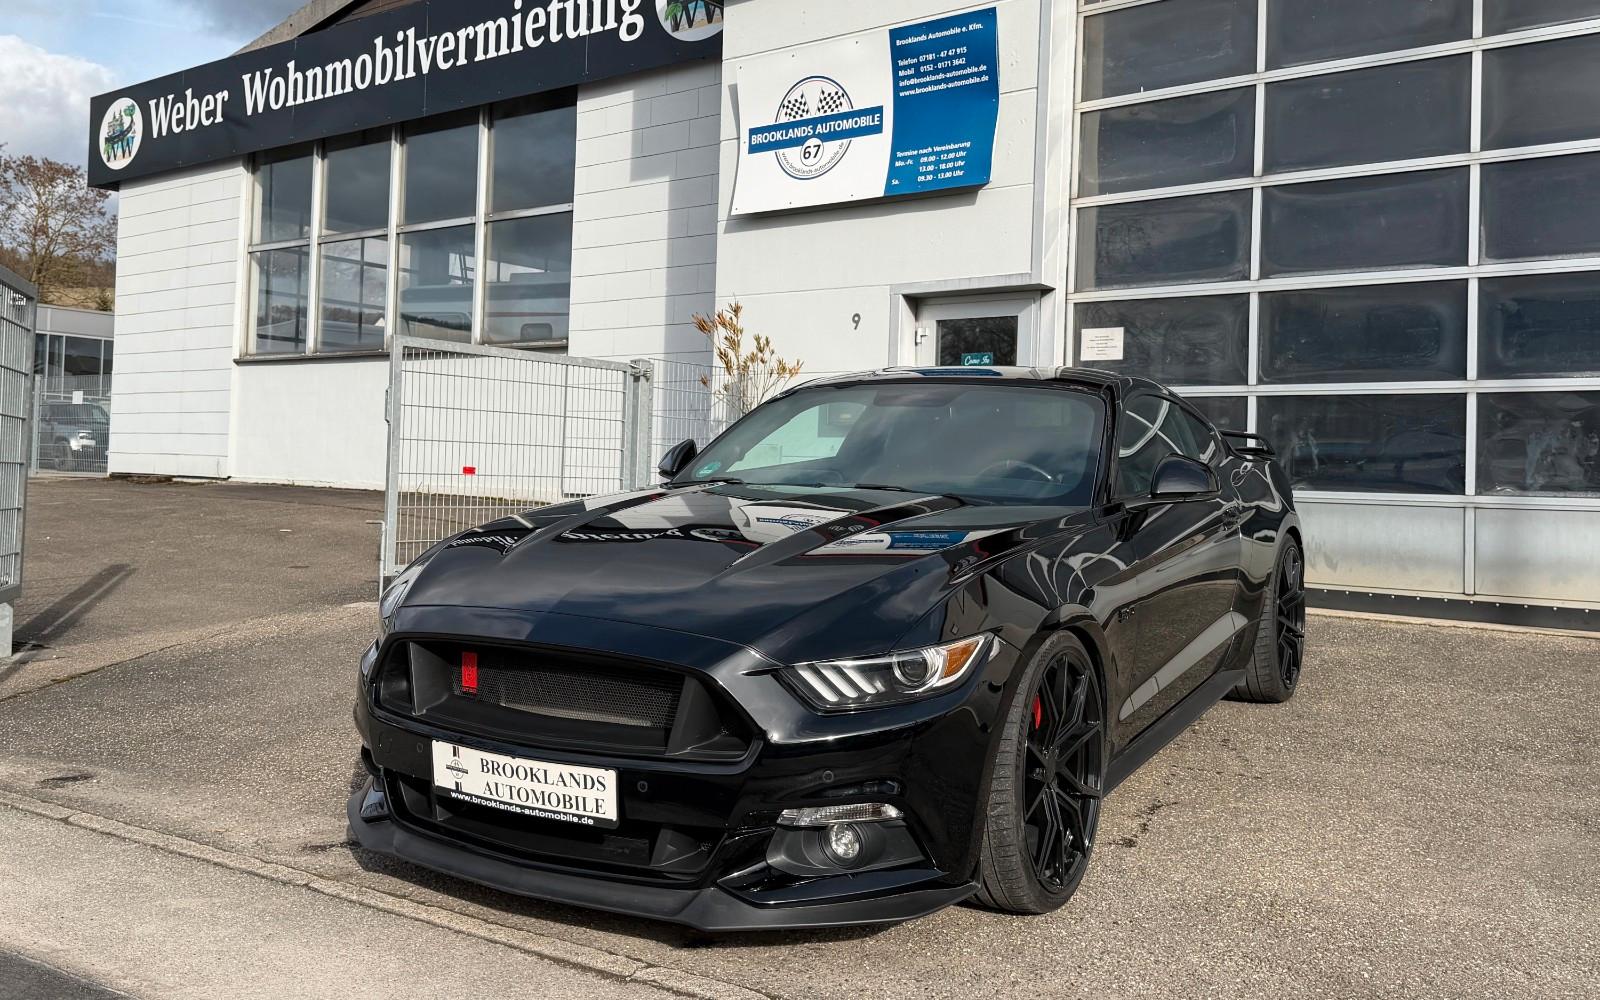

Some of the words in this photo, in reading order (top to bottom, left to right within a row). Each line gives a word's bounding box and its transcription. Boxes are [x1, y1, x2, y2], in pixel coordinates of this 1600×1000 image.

[896, 34, 927, 46] Brooklands
[928, 26, 961, 39] Automobile
[149, 88, 228, 138] Weber
[242, 0, 644, 116] Wohnmobilvermietung
[898, 58, 917, 66] Telefon
[919, 53, 935, 62] 07181
[899, 68, 914, 76] Mobil
[952, 58, 966, 66] 3642
[899, 64, 987, 87] info@brooklands-automobile.de
[900, 75, 989, 97] www.brooklands-automobile.de
[751, 125, 813, 145] BROOKLANDS
[815, 114, 880, 134] AUTOMOBILE
[803, 145, 821, 160] 67
[933, 141, 971, 152] Vereinbarung
[852, 313, 861, 330] 9
[480, 758, 606, 792] BROOKLANDS
[450, 792, 594, 825] www.brooklands-automobile.de
[483, 781, 606, 815] AUTOMOBILE
